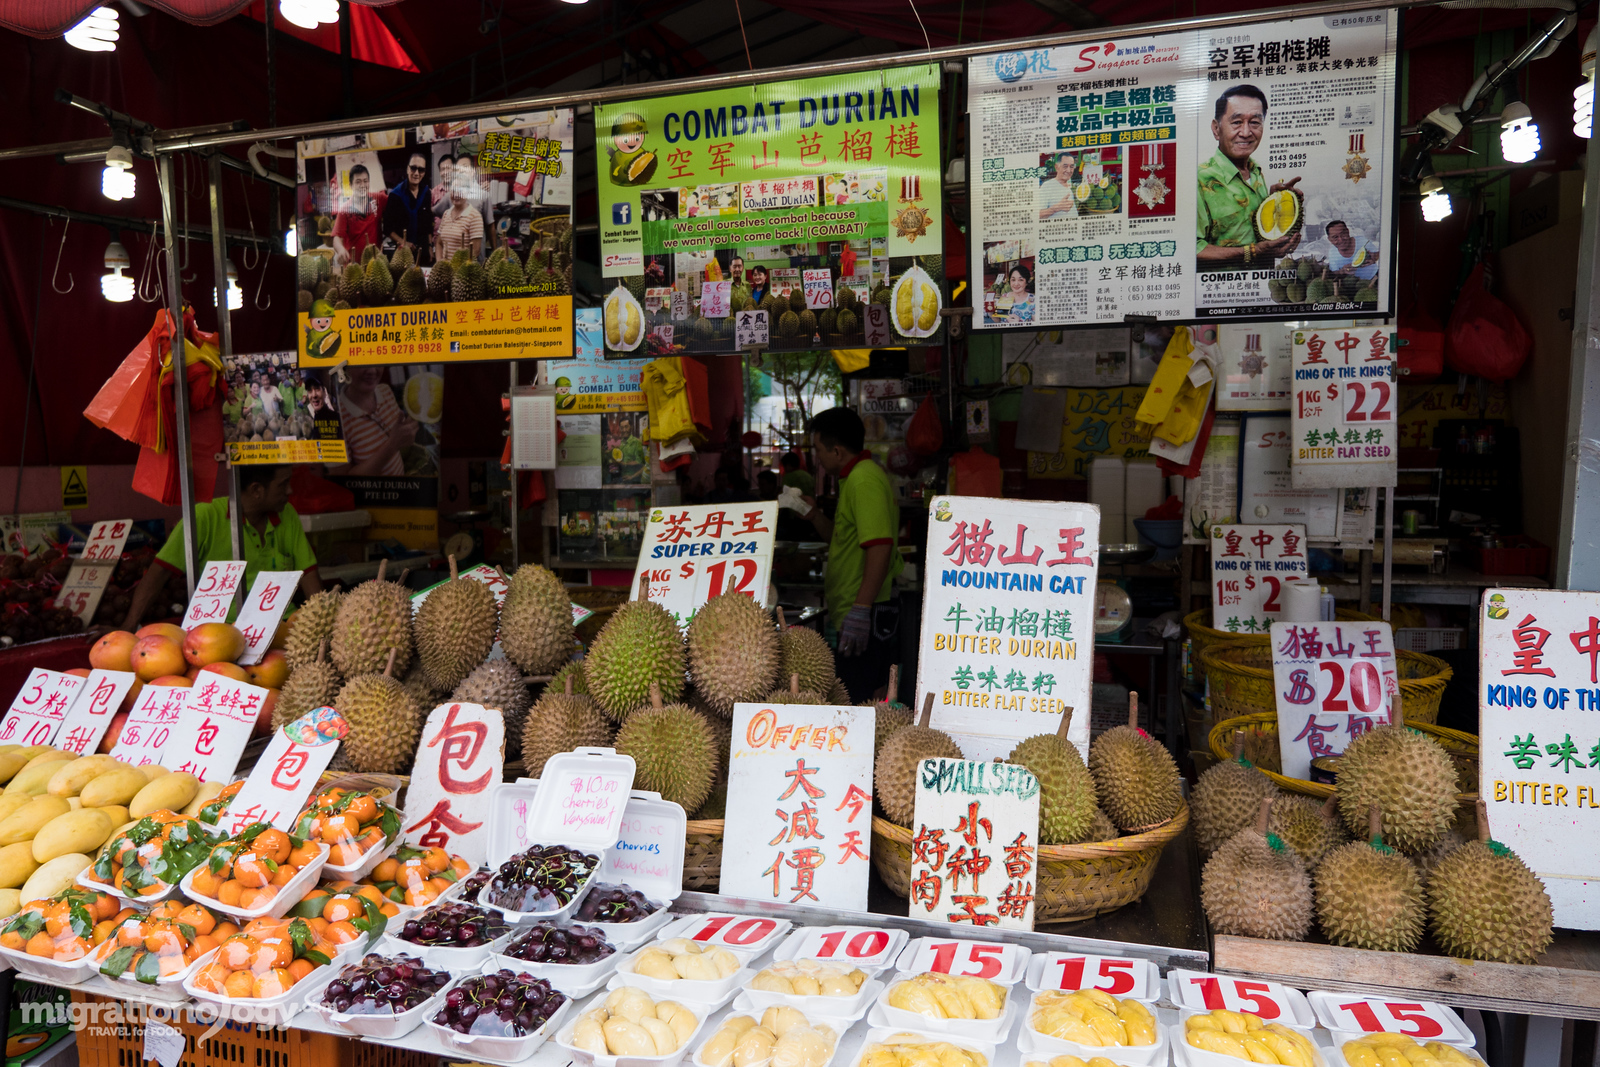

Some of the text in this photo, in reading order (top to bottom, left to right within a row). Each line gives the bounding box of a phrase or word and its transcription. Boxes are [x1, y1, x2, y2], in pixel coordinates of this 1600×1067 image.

[1073, 46, 1180, 73] Singapore Brands
[1207, 36, 1331, 70] 空军榴梿摊
[1056, 85, 1177, 113] 皇中皇榴梿
[663, 83, 920, 144] COMBAT DURIAN
[1056, 106, 1176, 134] 极品中极品
[1268, 162, 1287, 170] 9029
[1269, 154, 1287, 162] 8143
[696, 210, 856, 232] call ourselves combat because
[663, 239, 679, 248] we
[681, 236, 706, 247] want
[708, 236, 728, 247] you
[730, 233, 741, 244] to
[743, 231, 772, 243] come
[775, 227, 804, 240] back!
[506, 283, 540, 295] November
[541, 282, 557, 292] 2013
[804, 281, 829, 290] OFFER
[1146, 285, 1163, 293] 8143
[1165, 283, 1181, 292] 0495
[1201, 269, 1296, 283] COMBAT DURIAN
[813, 290, 832, 305] 10
[1146, 293, 1163, 302] 9029
[1165, 291, 1181, 300] 2837
[1312, 303, 1334, 311] Come
[348, 309, 448, 329] COMBAT DURIAN
[1095, 312, 1115, 320] Linda
[1165, 309, 1181, 317] 9928
[349, 328, 402, 344] Linda Ang
[470, 325, 563, 337] combatdurian@hotmail.com
[391, 342, 442, 355] 9278 9928
[483, 342, 503, 350] Durian
[1302, 329, 1393, 366] 皇中皇
[1295, 365, 1392, 380] KING OF THE KING'S
[578, 384, 613, 394] COMBAT
[1345, 380, 1391, 422] 22
[578, 402, 594, 410] Linda
[595, 402, 607, 410] Ang
[1070, 389, 1130, 416] D24
[242, 443, 261, 451] COMBAT
[1298, 444, 1391, 459] BITTER FLAT SEED
[345, 480, 420, 490] COMBAT DURIAN
[364, 491, 400, 500] PTE LTD
[656, 510, 770, 544] 苏丹王
[650, 540, 758, 559] SUPER D24
[942, 518, 1094, 568] 猫山王
[1220, 529, 1304, 558] 皇中皇
[1214, 560, 1306, 572] KING OF THE KING'S
[941, 568, 1087, 595] MOUNTAIN CAT
[933, 632, 1077, 660] BUTTER DURIAN
[1278, 625, 1392, 659] 猫山王
[1319, 661, 1382, 713] 20
[1487, 684, 1570, 710] KING OF
[942, 689, 1065, 715] BITTER FLAT SEED
[745, 708, 851, 753] OFFER
[921, 758, 990, 796] SMALL
[1493, 779, 1568, 807] BITTER
[834, 782, 873, 865] 今天
[996, 831, 1035, 921] 香甜
[692, 915, 778, 945] 10
[815, 930, 892, 958] 10
[929, 942, 1004, 979] 15
[1056, 956, 1136, 995] 15
[1189, 976, 1282, 1020] 15
[1338, 1000, 1444, 1038] 15
